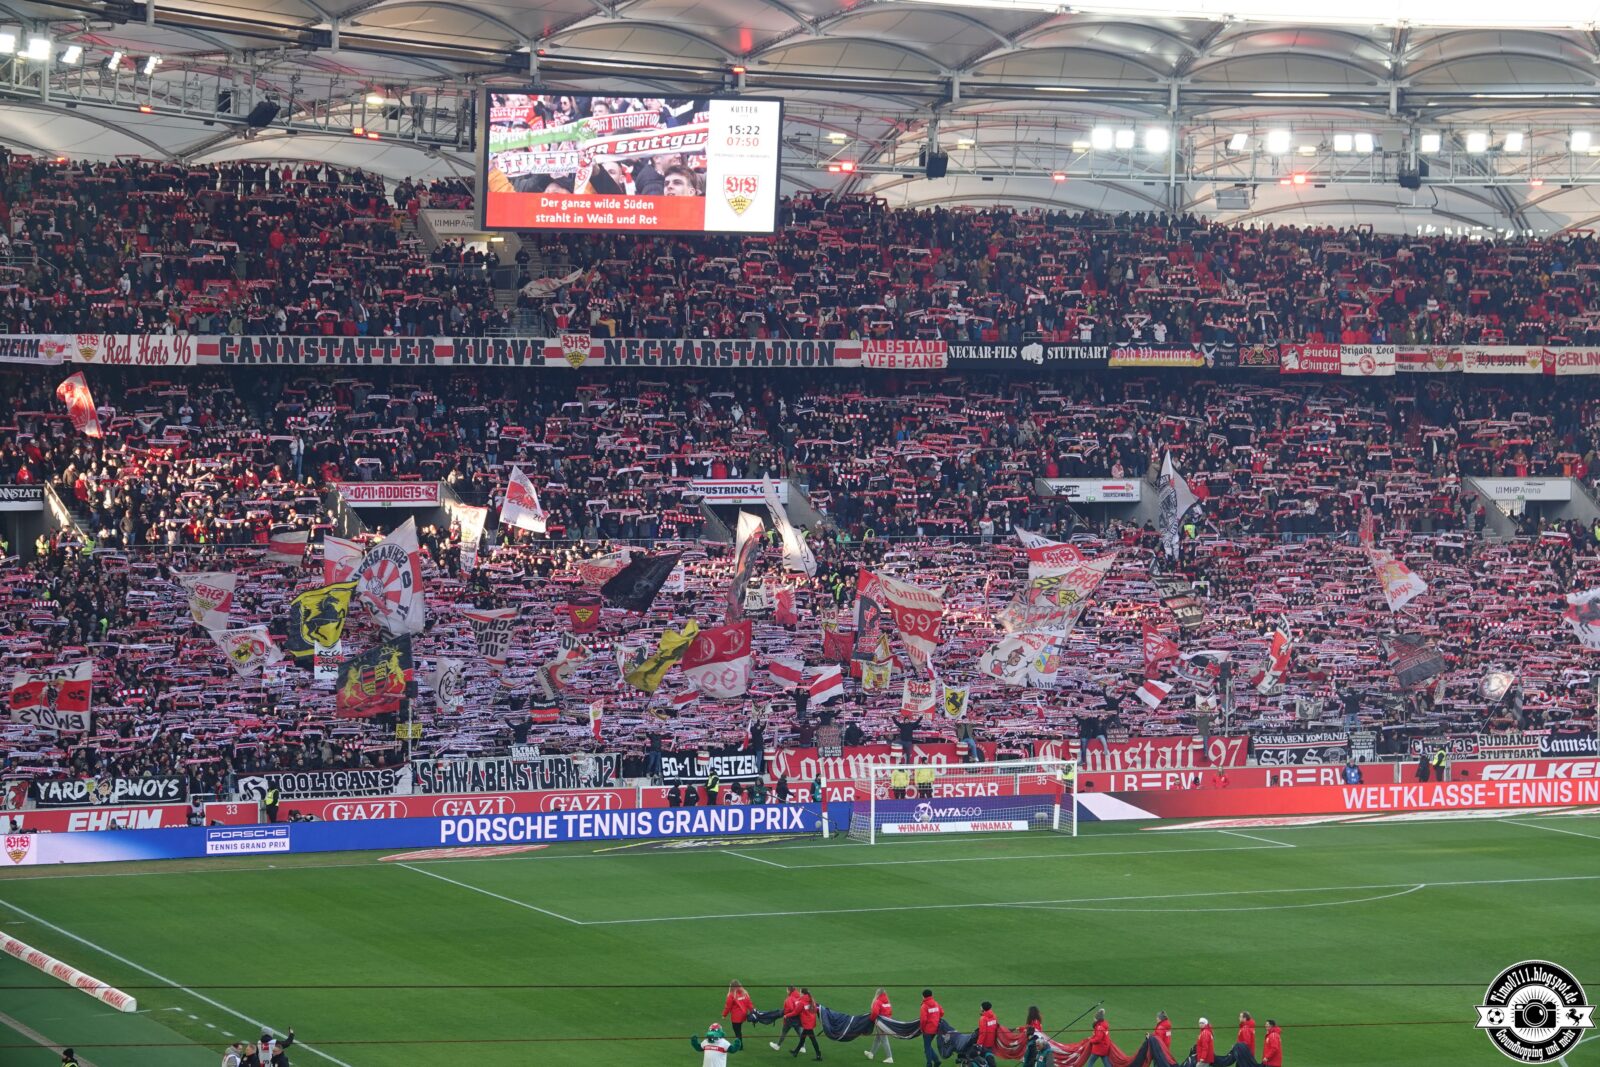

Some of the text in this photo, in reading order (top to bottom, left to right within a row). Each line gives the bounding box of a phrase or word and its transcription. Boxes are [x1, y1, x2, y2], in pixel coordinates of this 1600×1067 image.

[728, 125, 760, 135] 15:22
[726, 137, 759, 147] 07:50
[726, 177, 757, 193] VfB
[541, 198, 654, 210] Der ganze wilde Süden
[536, 212, 658, 225] strahlt in Weiß und Rot
[77, 334, 99, 347] VfB
[562, 334, 591, 350] VfB
[866, 341, 947, 353] ALBSTADT
[102, 334, 191, 364] Red Hots 96
[219, 337, 546, 366] CANNSTATTER KURVE
[603, 338, 836, 369] NECKARSTADION
[949, 345, 1109, 360] NECKAR-FILS STUTTGART
[1116, 346, 1193, 362] Old Warriors
[868, 353, 944, 368] VFB-FANS
[1503, 486, 1541, 494] MHP Arena
[1252, 734, 1304, 744] SCHWABEN
[1305, 732, 1348, 742] KOMPANIE
[1455, 738, 1474, 753] 36
[1039, 738, 1243, 774] Cnnstatt 97
[1480, 750, 1540, 759] STUTTGART
[661, 757, 690, 777] 50+1
[264, 769, 395, 793] HOOLIGANS
[1036, 774, 1048, 786] 35
[36, 778, 180, 801] YARD BWOYS
[1342, 780, 1599, 809] WELTKLASSE-TENNIS IN
[226, 804, 238, 815] 33
[440, 805, 805, 844] PORSCHE TENNIS GRAND PRIX
[897, 821, 1013, 833] WINAMAX WINAMAX
[210, 829, 287, 839] PORSCHE
[6, 836, 30, 849] VfB
[211, 841, 286, 851] TENNIS GRAND PRIX
